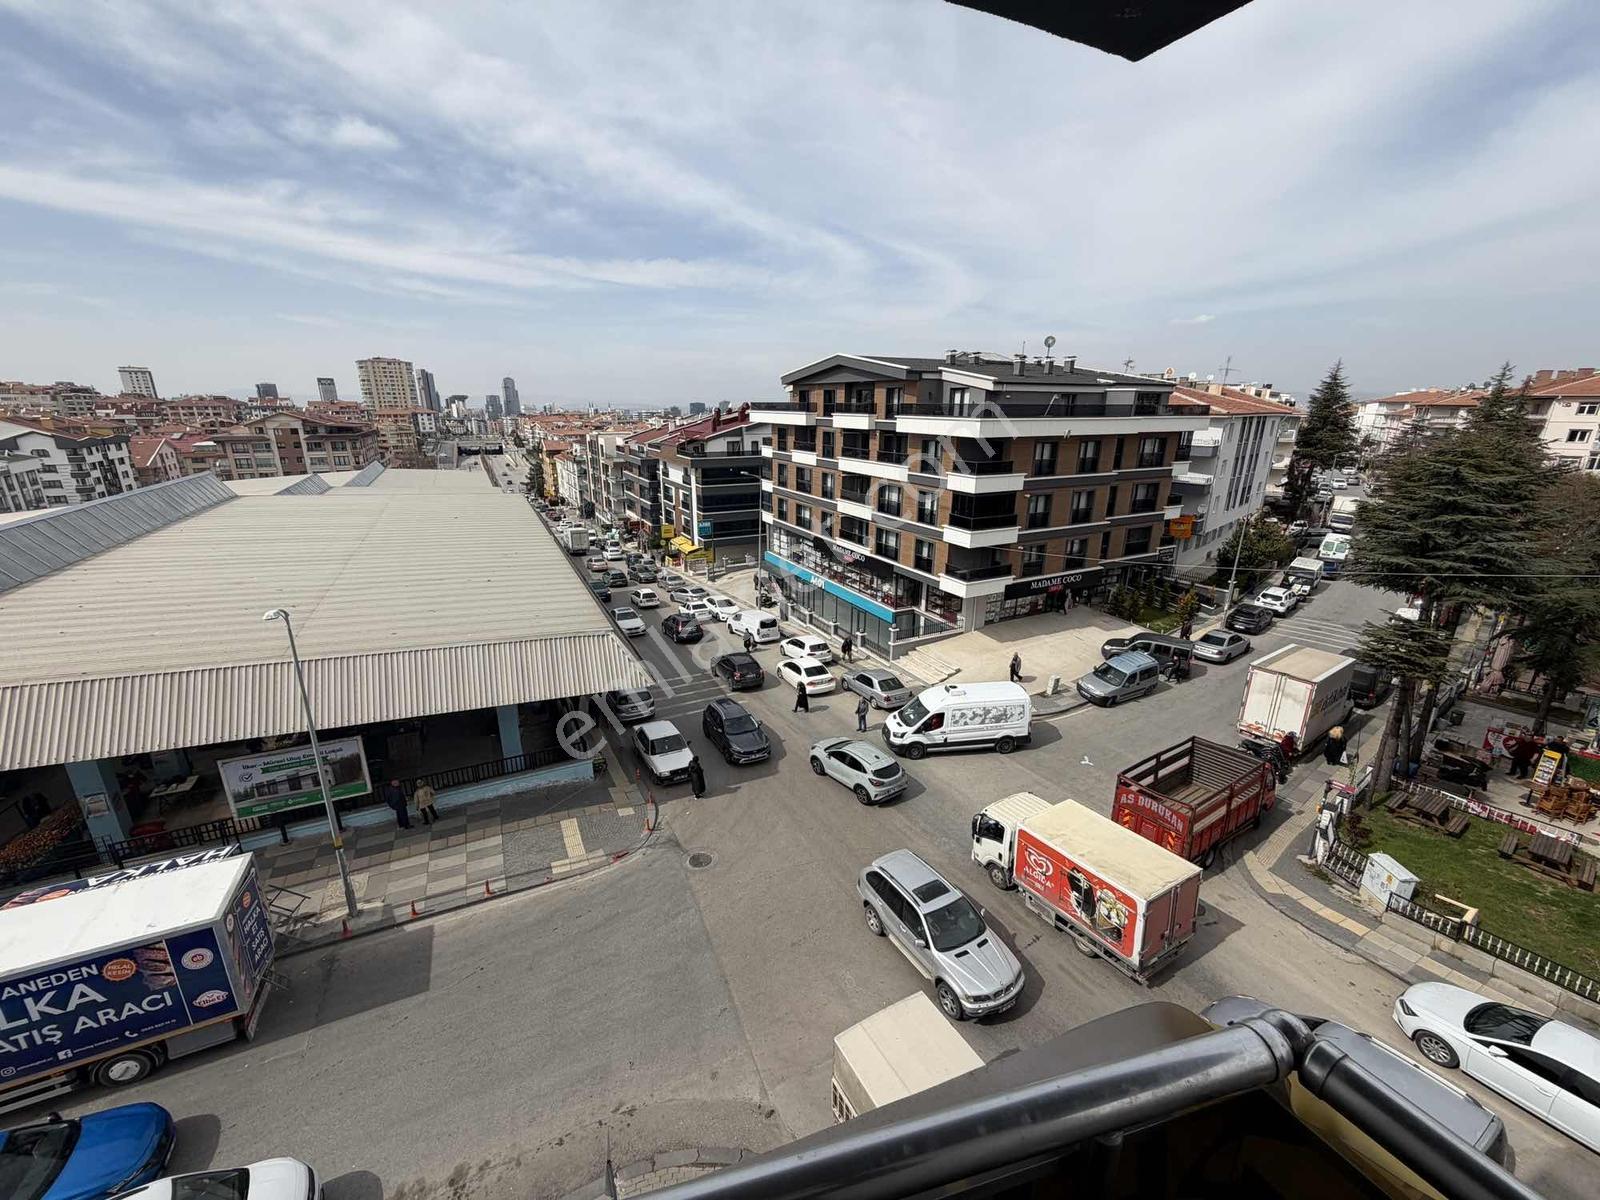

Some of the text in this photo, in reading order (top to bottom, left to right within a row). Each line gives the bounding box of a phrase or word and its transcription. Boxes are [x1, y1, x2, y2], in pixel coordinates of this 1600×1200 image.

[1031, 577, 1062, 589] MADAME
[1063, 574, 1082, 584] COCO
[1120, 794, 1135, 804] AS
[1023, 865, 1053, 889] ALGIDA
[74, 991, 173, 1035] ARACI
